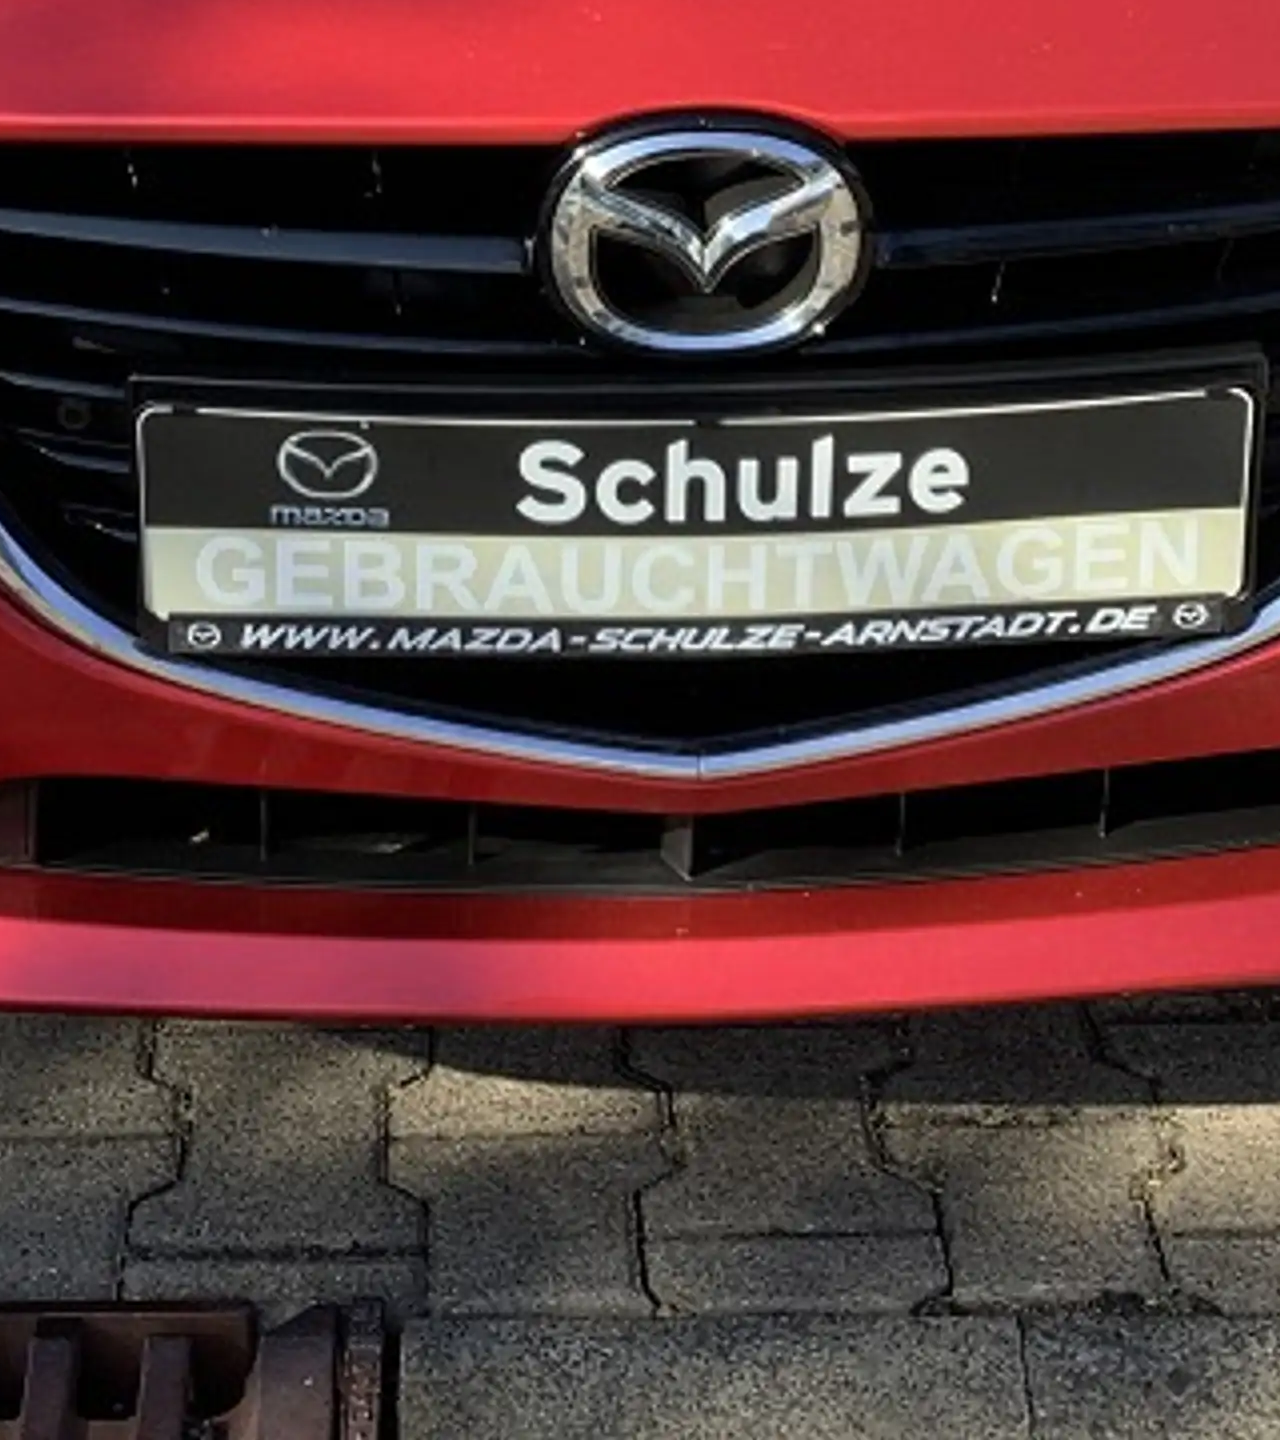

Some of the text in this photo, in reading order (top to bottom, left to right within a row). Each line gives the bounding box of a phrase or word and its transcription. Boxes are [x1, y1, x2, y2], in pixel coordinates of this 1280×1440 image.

[516, 435, 970, 525] Schulze
[195, 519, 1198, 613] GEBRAUCHTWAGEN
[239, 605, 1157, 653] WWW.MAZDA-SCHULZE-ARNSTADT.DE
